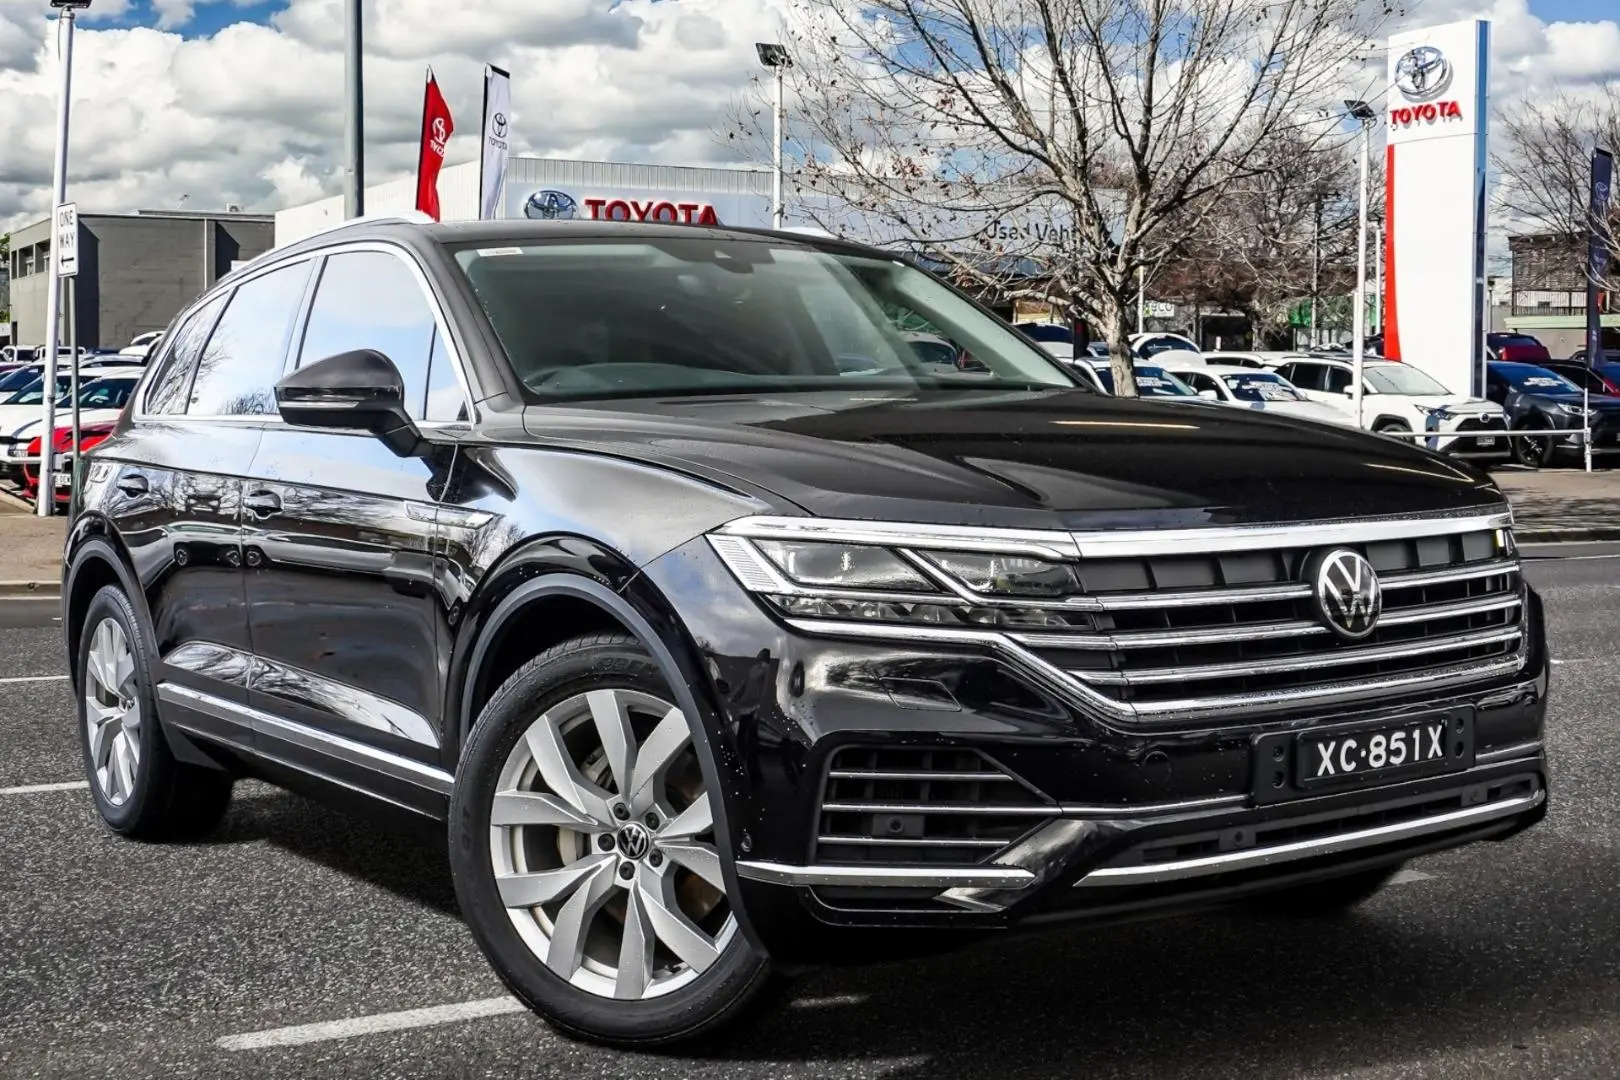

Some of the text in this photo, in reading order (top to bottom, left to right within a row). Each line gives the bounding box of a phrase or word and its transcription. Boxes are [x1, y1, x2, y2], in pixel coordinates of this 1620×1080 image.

[1389, 101, 1463, 125] TOYOTA
[60, 209, 74, 228] ONE
[585, 199, 719, 227] TOYOTA
[60, 231, 76, 249] WAY
[986, 218, 1030, 241] Used
